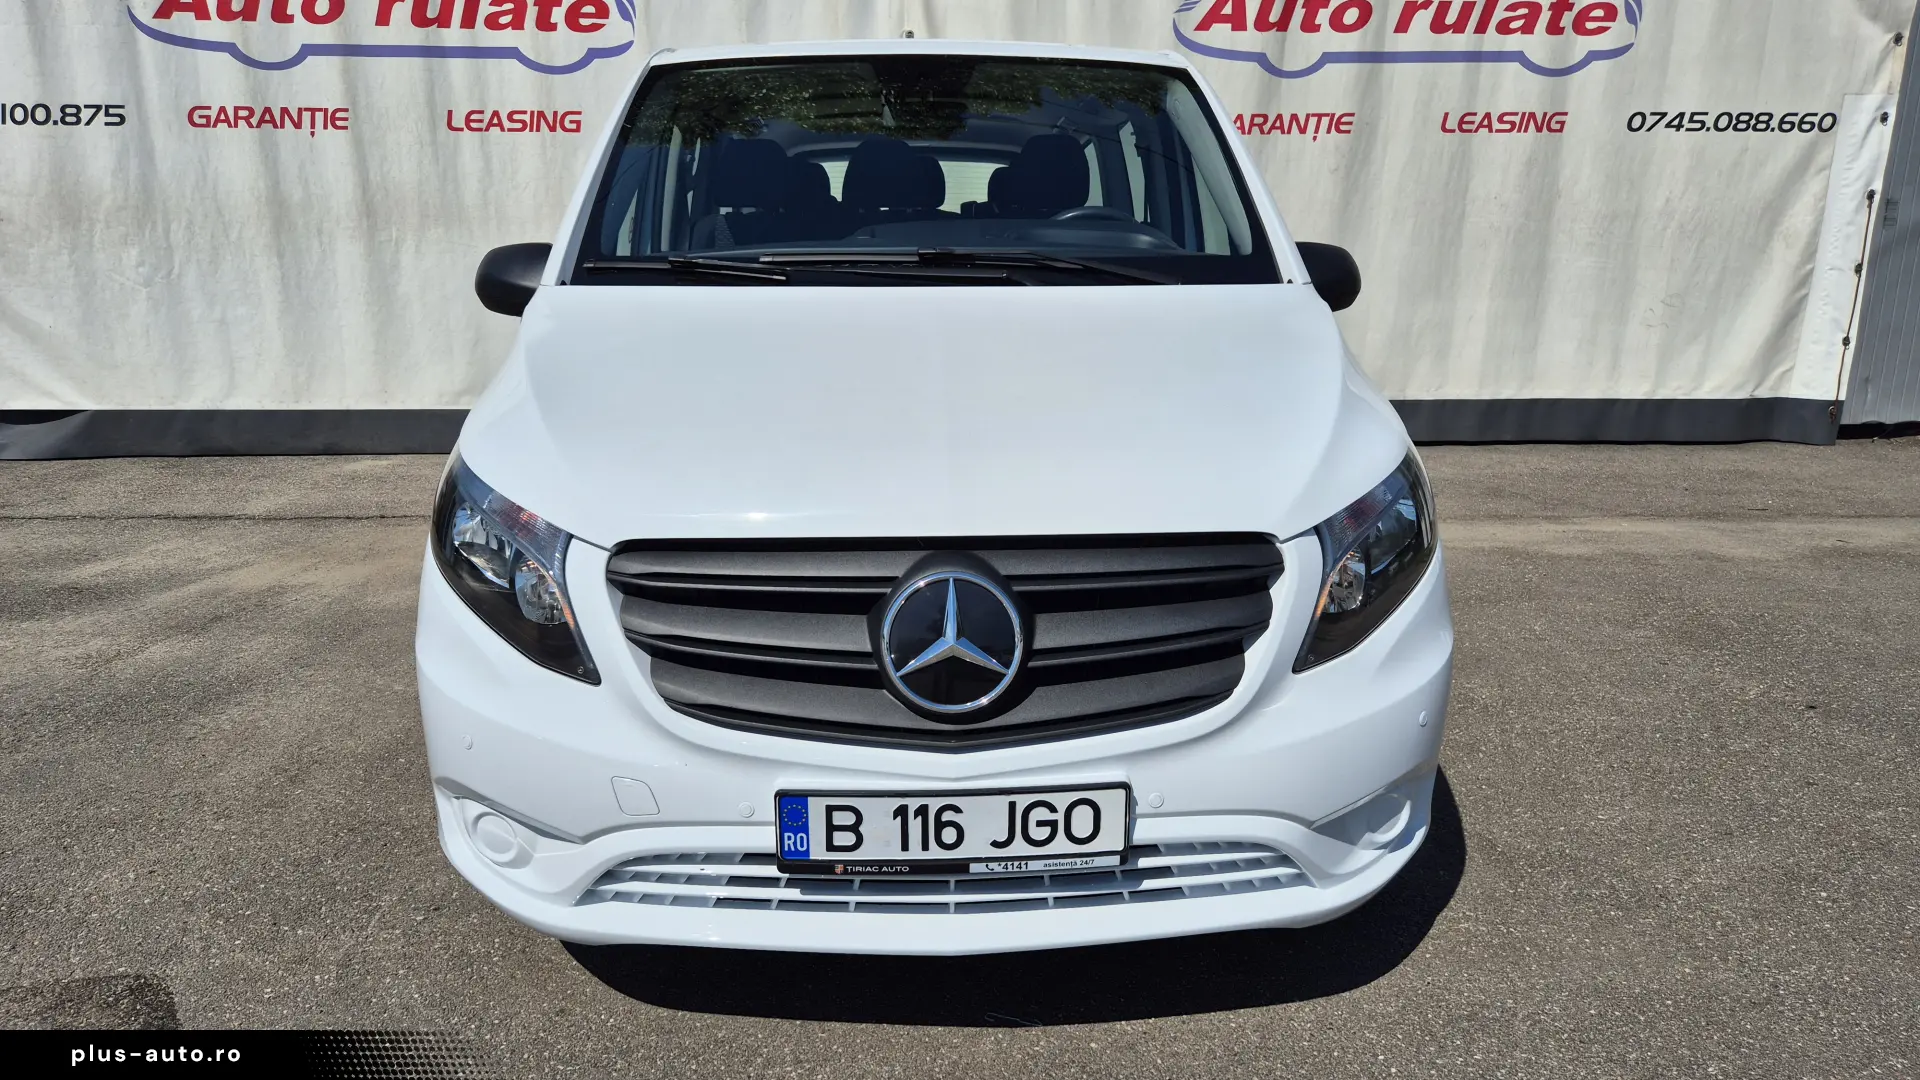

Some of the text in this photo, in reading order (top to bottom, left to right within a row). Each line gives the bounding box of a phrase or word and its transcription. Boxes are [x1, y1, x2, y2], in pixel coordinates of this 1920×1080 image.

[1194, 0, 1619, 37] Auto rulate
[187, 105, 350, 138] GARANȚIE
[446, 109, 583, 134] LEASING
[1233, 112, 1356, 142] ARANȚIE
[1441, 111, 1569, 134] LEASING
[1626, 111, 1837, 133] 0745.088.660
[824, 797, 1102, 853] B 116 JGO
[784, 832, 808, 852] RO
